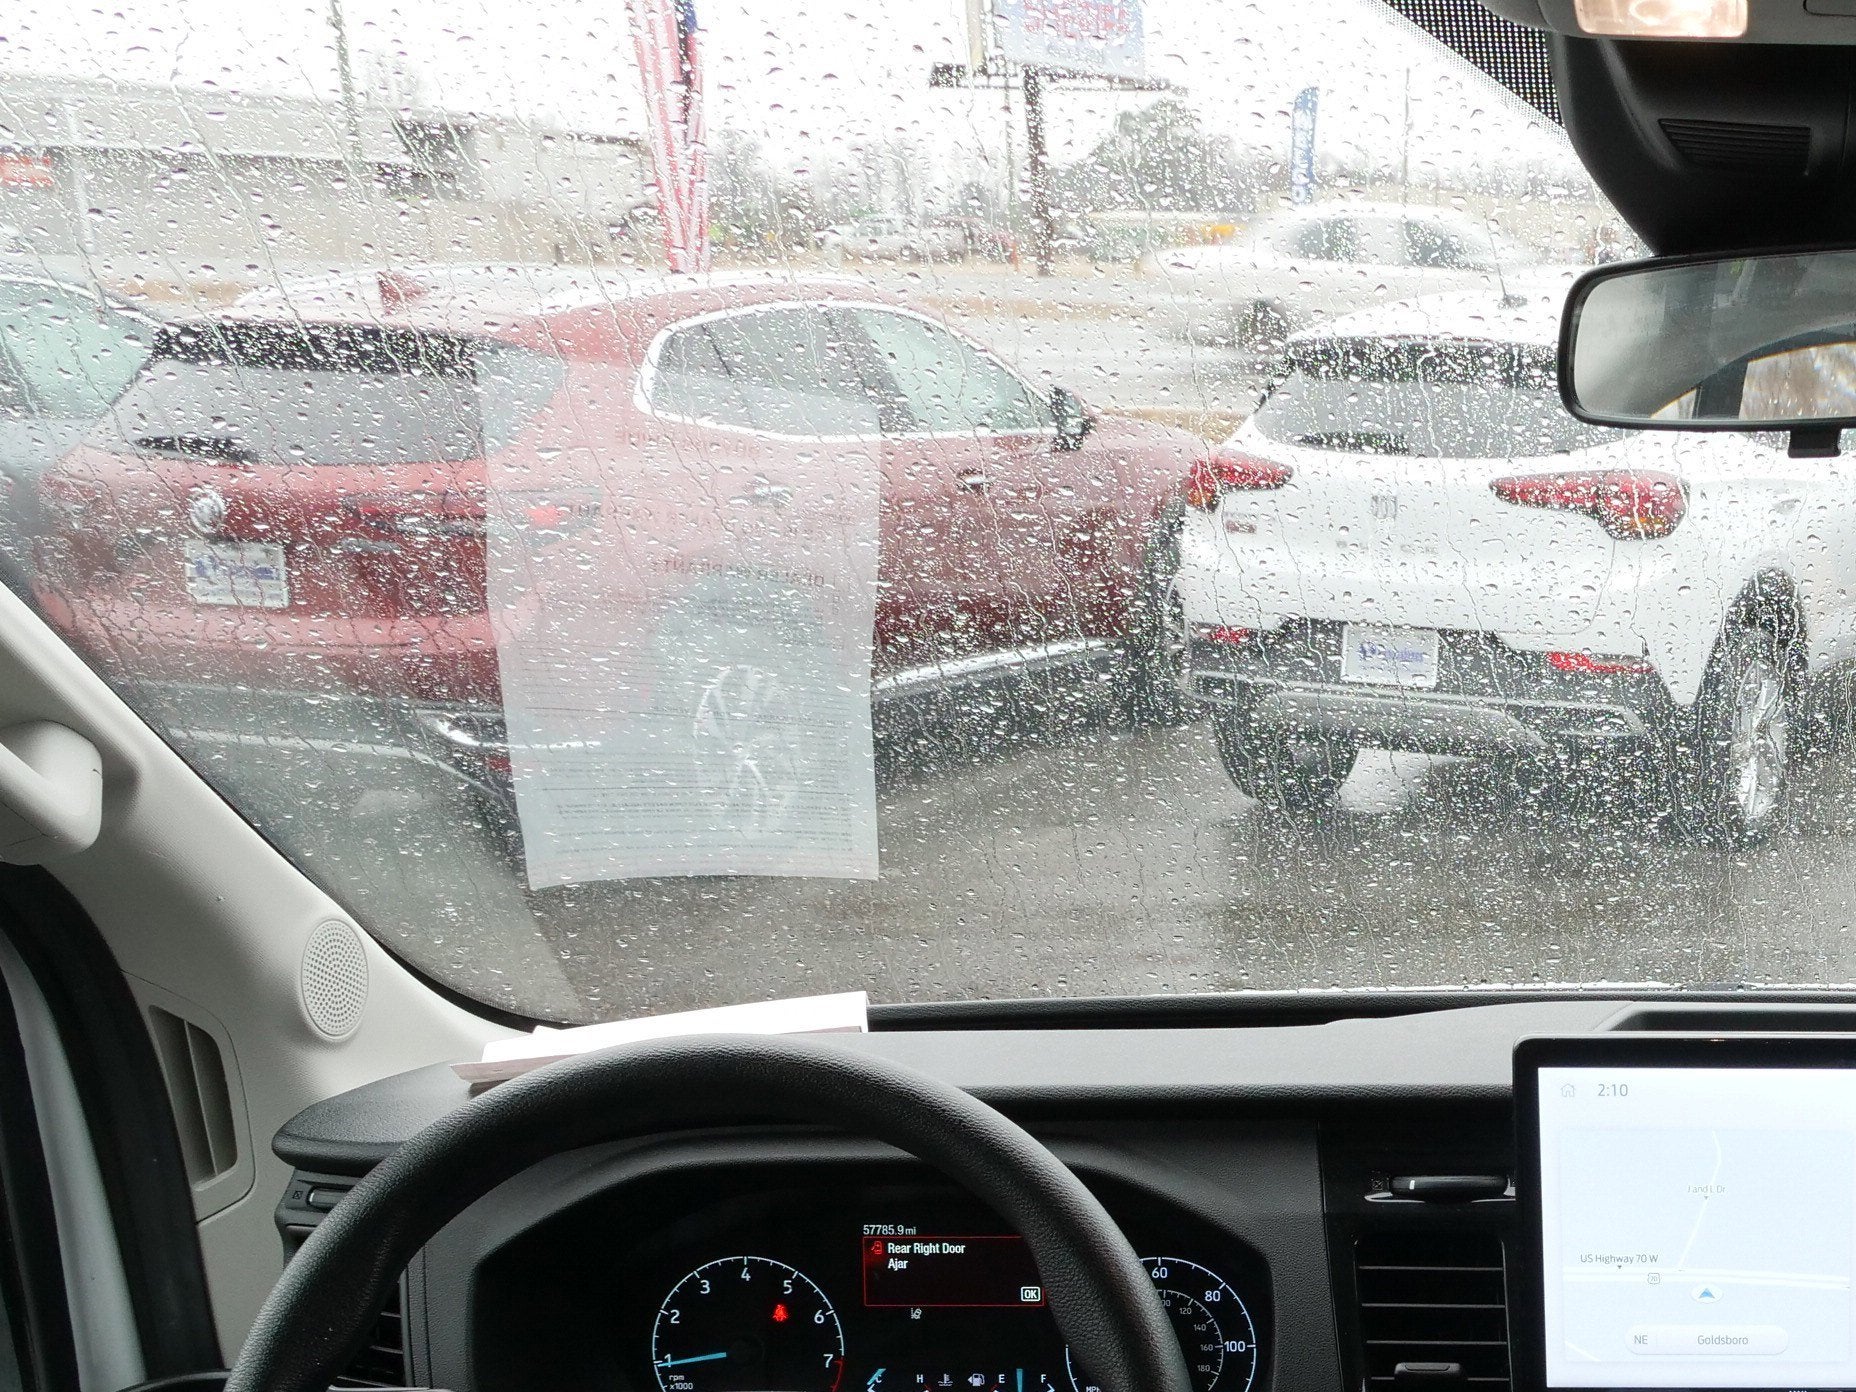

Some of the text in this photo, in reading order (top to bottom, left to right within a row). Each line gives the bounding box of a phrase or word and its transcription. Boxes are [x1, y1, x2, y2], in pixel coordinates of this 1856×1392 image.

[1598, 1083, 1629, 1097] 2:10
[887, 1242, 966, 1256] Rear Right Door
[887, 1258, 909, 1271] Ajar
[1580, 1253, 1659, 1266] US Highway 70 W
[740, 1267, 751, 1282] 4
[1151, 1267, 1168, 1279] 60
[699, 1279, 711, 1295] 3
[783, 1279, 793, 1295] 5
[1024, 1289, 1038, 1299] OK
[1204, 1290, 1221, 1302] 80
[670, 1309, 680, 1324] 2
[814, 1309, 825, 1324] 6
[1179, 1307, 1192, 1315] 120
[1193, 1323, 1207, 1332] 140
[1633, 1334, 1749, 1345] NE Goldsboro
[1200, 1343, 1214, 1351] 160
[1224, 1340, 1246, 1353] 100
[823, 1353, 834, 1369] 7
[1197, 1364, 1211, 1372] 180
[668, 1374, 685, 1382] rpm
[916, 1374, 924, 1383] H
[998, 1374, 1005, 1383] E
[1040, 1374, 1047, 1383] F
[669, 1382, 694, 1390] x1000
